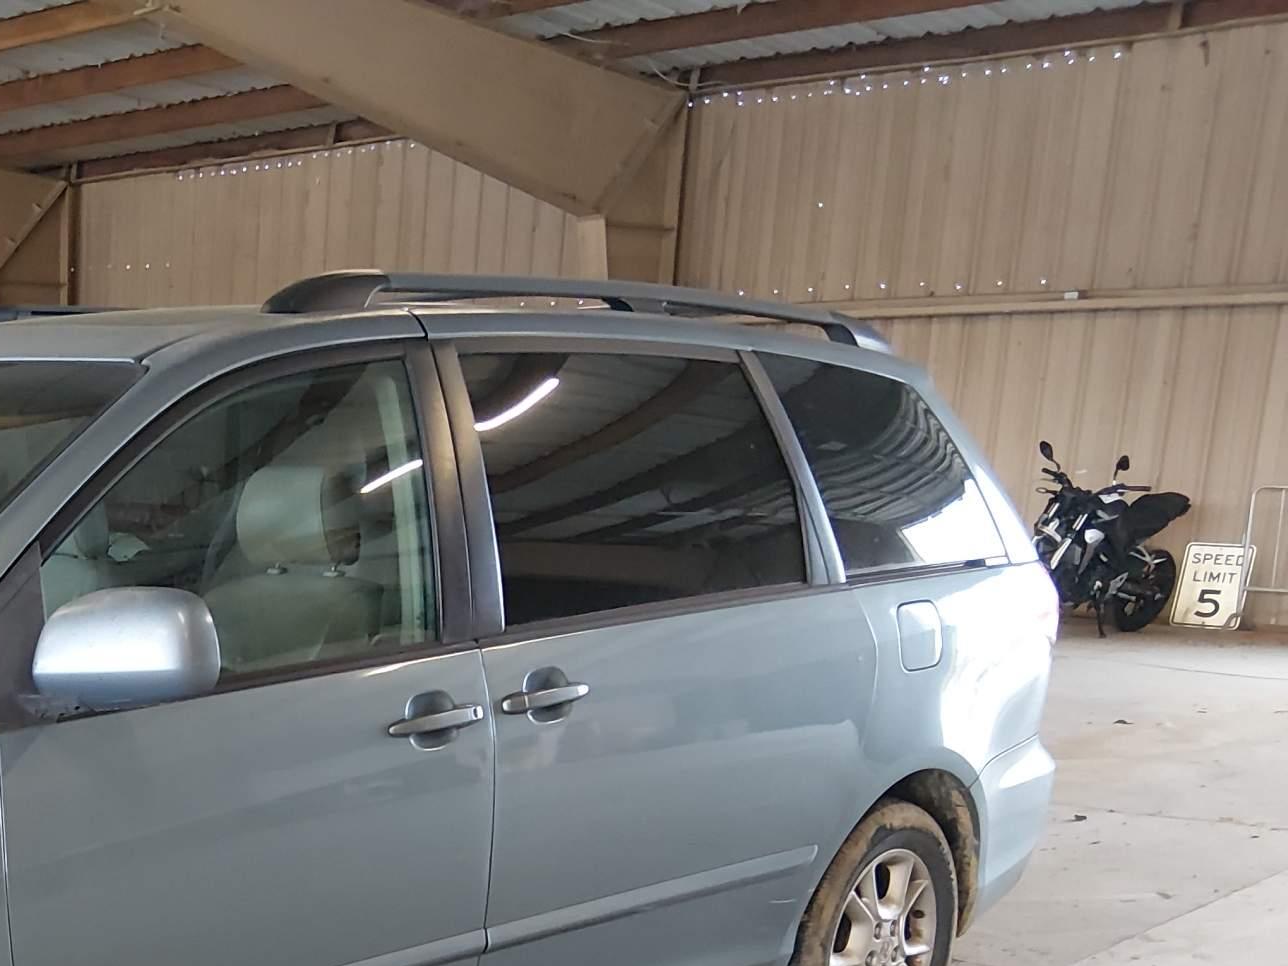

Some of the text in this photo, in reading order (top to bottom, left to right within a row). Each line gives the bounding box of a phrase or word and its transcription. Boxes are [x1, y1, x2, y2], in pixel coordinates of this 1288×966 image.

[1192, 553, 1245, 566] SPEED
[1192, 570, 1238, 584] LIMIT
[1193, 589, 1222, 618] 5
